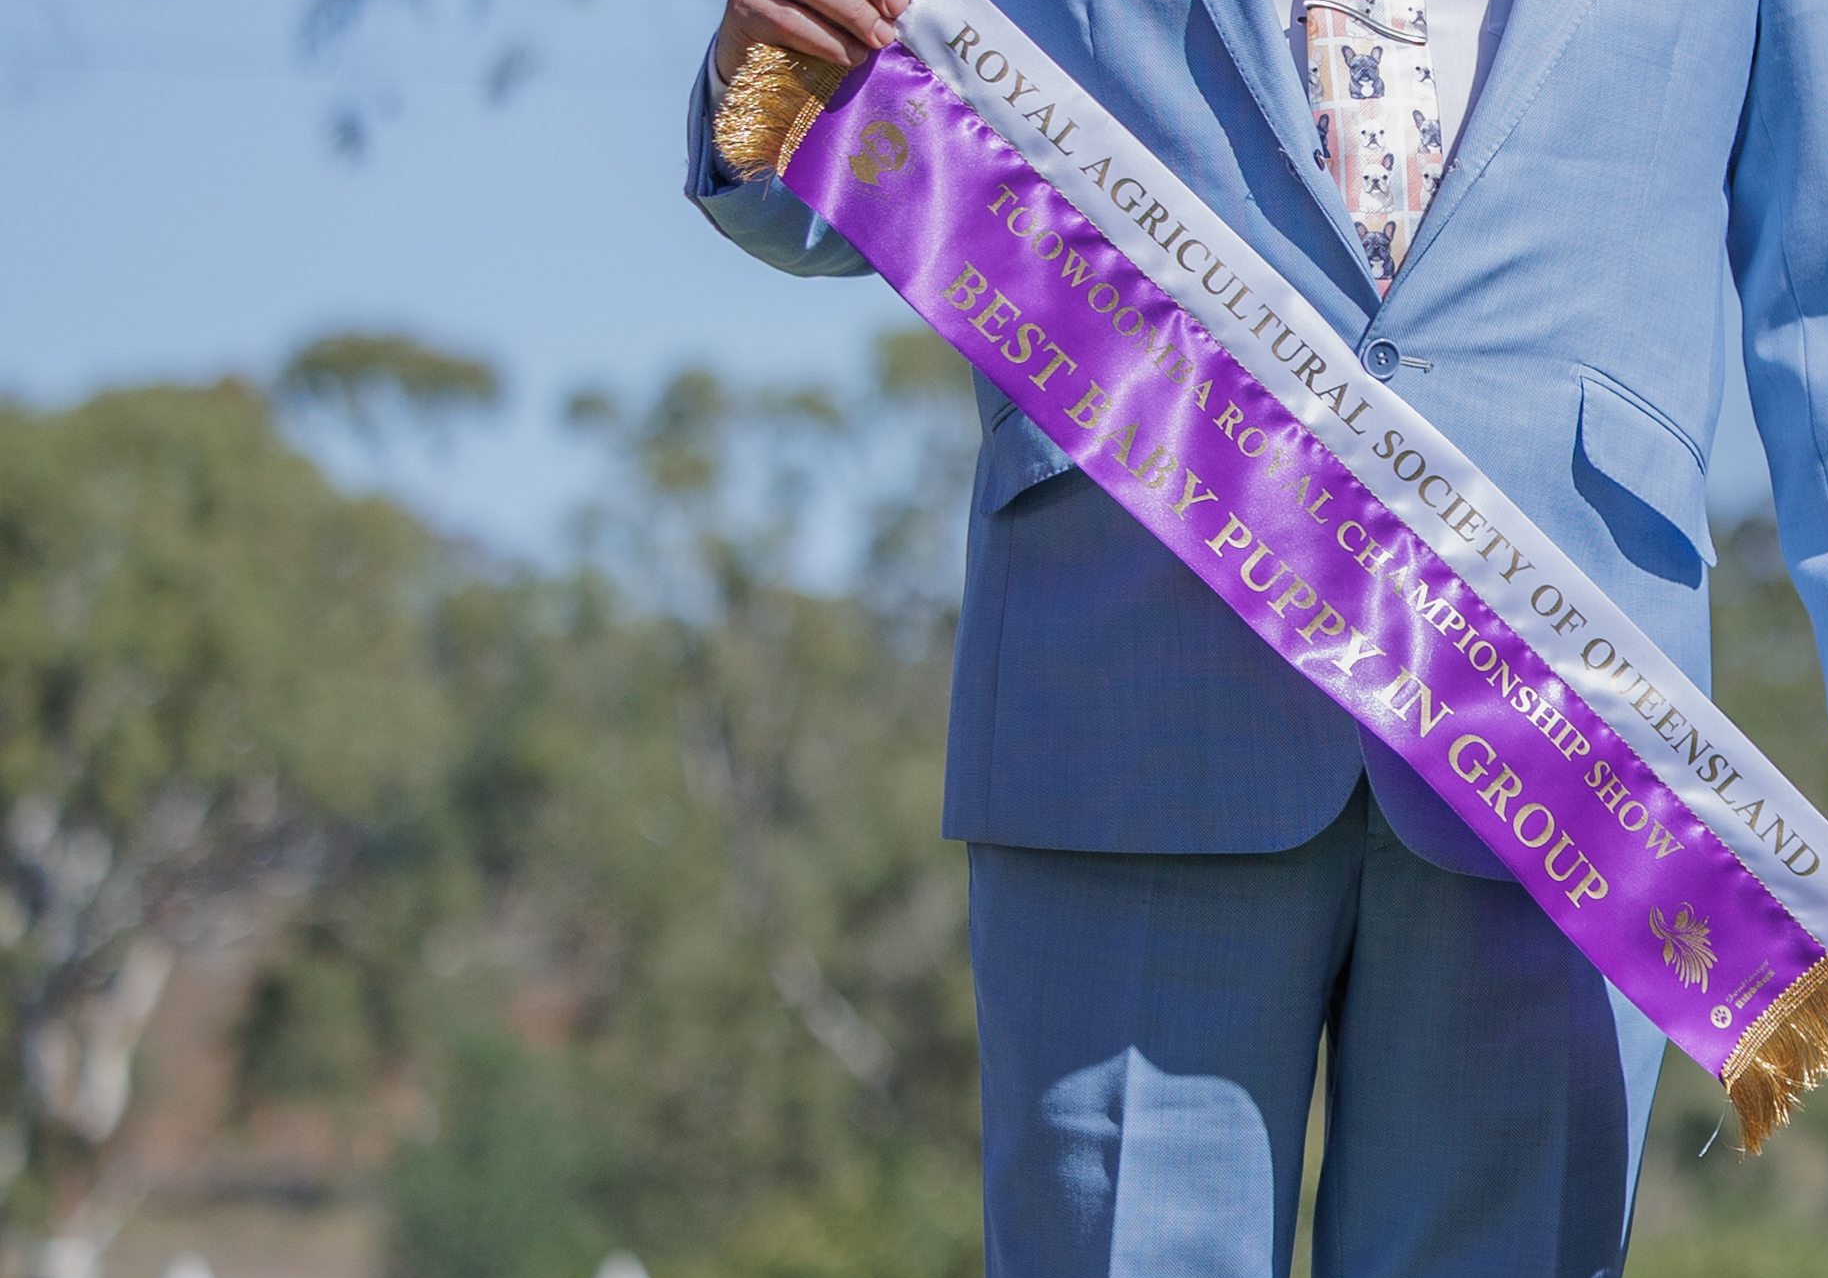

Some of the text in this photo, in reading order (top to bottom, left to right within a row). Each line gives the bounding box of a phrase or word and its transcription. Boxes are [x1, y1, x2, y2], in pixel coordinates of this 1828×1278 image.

[940, 260, 1609, 909] BEST BABY PUPPY IN GROUP
[946, 21, 1080, 156] ROYAL
[1080, 156, 1373, 435] AGRICULTURAL
[1372, 430, 1536, 584] SOCIETY
[1531, 584, 1588, 636] OF
[1580, 637, 1821, 877] QUEENSLAND
[986, 183, 1684, 862] TOOWOOMBA ROYAL CHAMPIONSHIP SHOW
